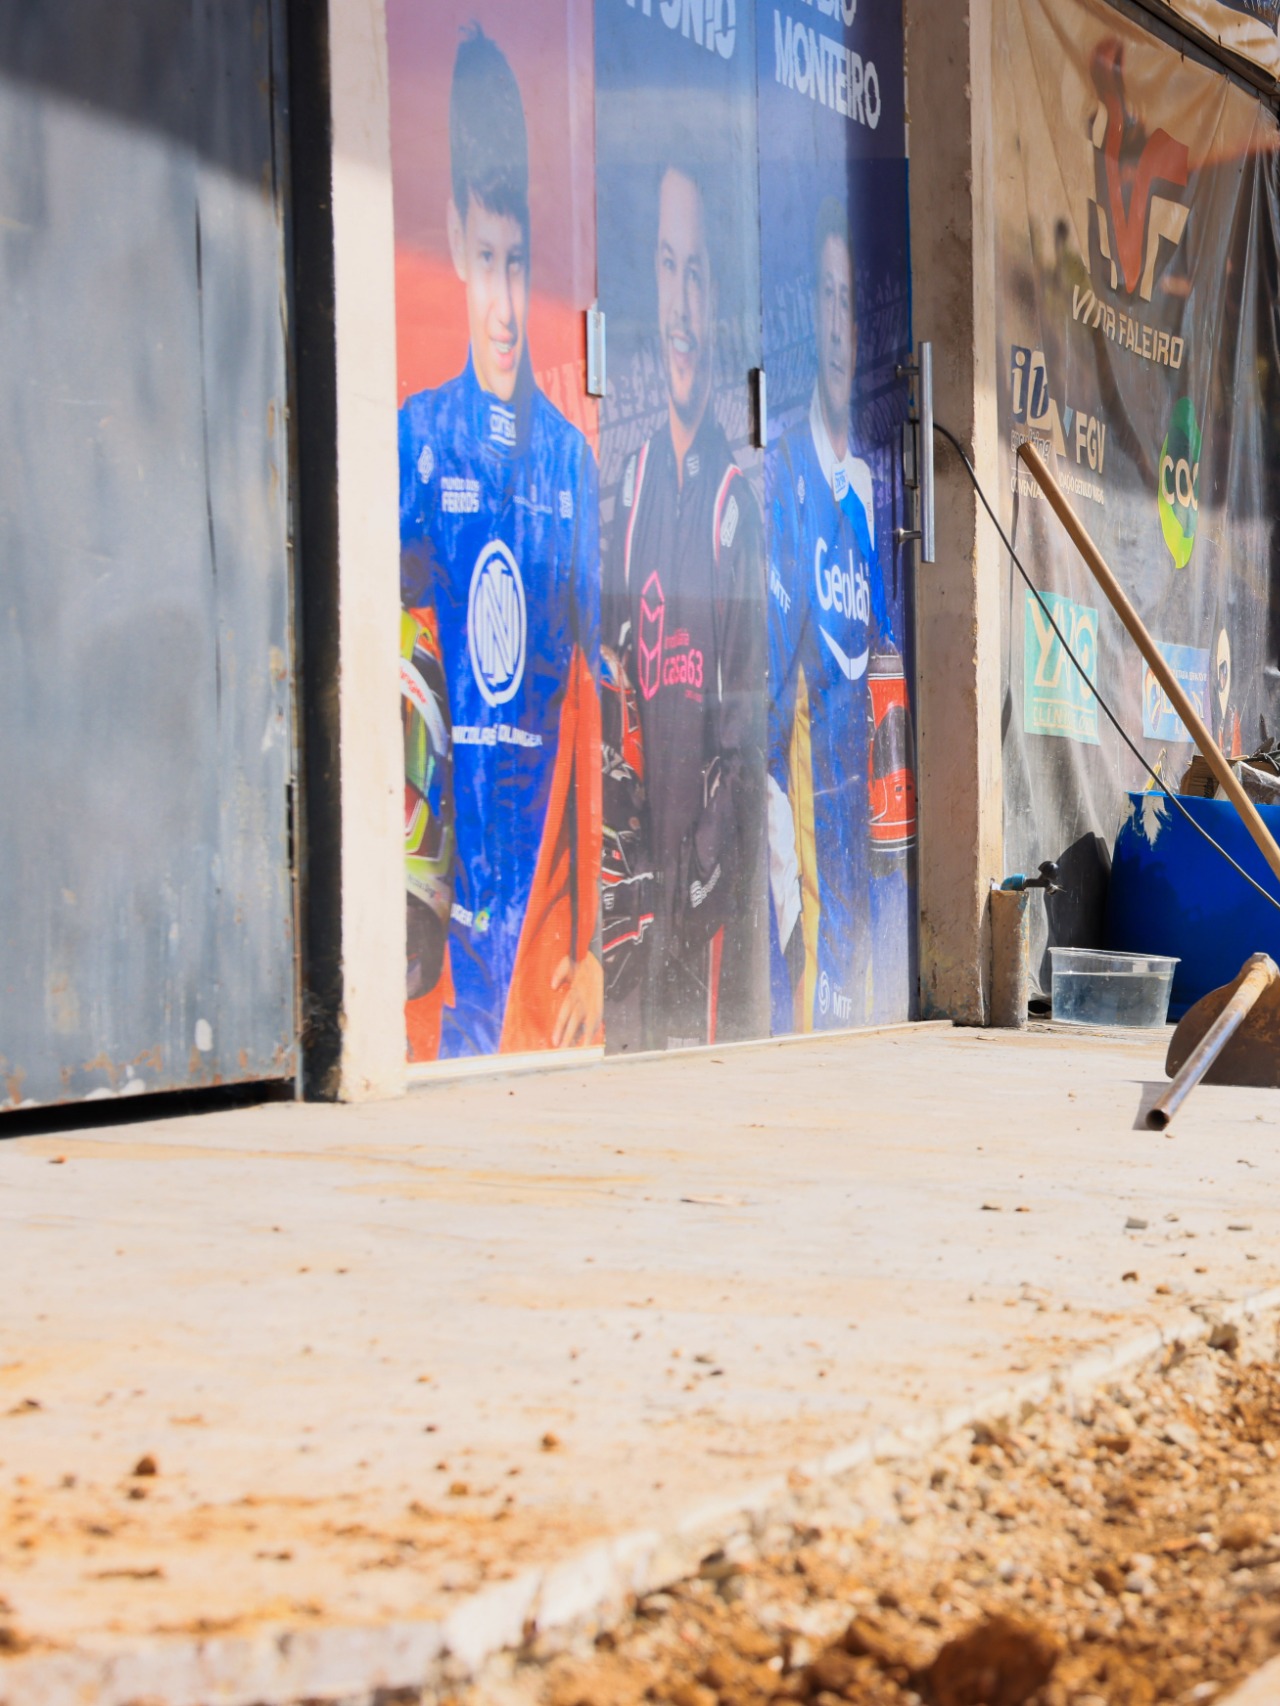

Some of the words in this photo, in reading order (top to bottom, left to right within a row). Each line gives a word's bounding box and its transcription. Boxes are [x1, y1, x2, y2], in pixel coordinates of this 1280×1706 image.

[774, 9, 881, 129] MONTEIRO
[1118, 312, 1184, 369] FALEIRO
[1076, 411, 1106, 474] FGV
[815, 536, 870, 626] Geolab
[833, 991, 852, 1019] MTF
